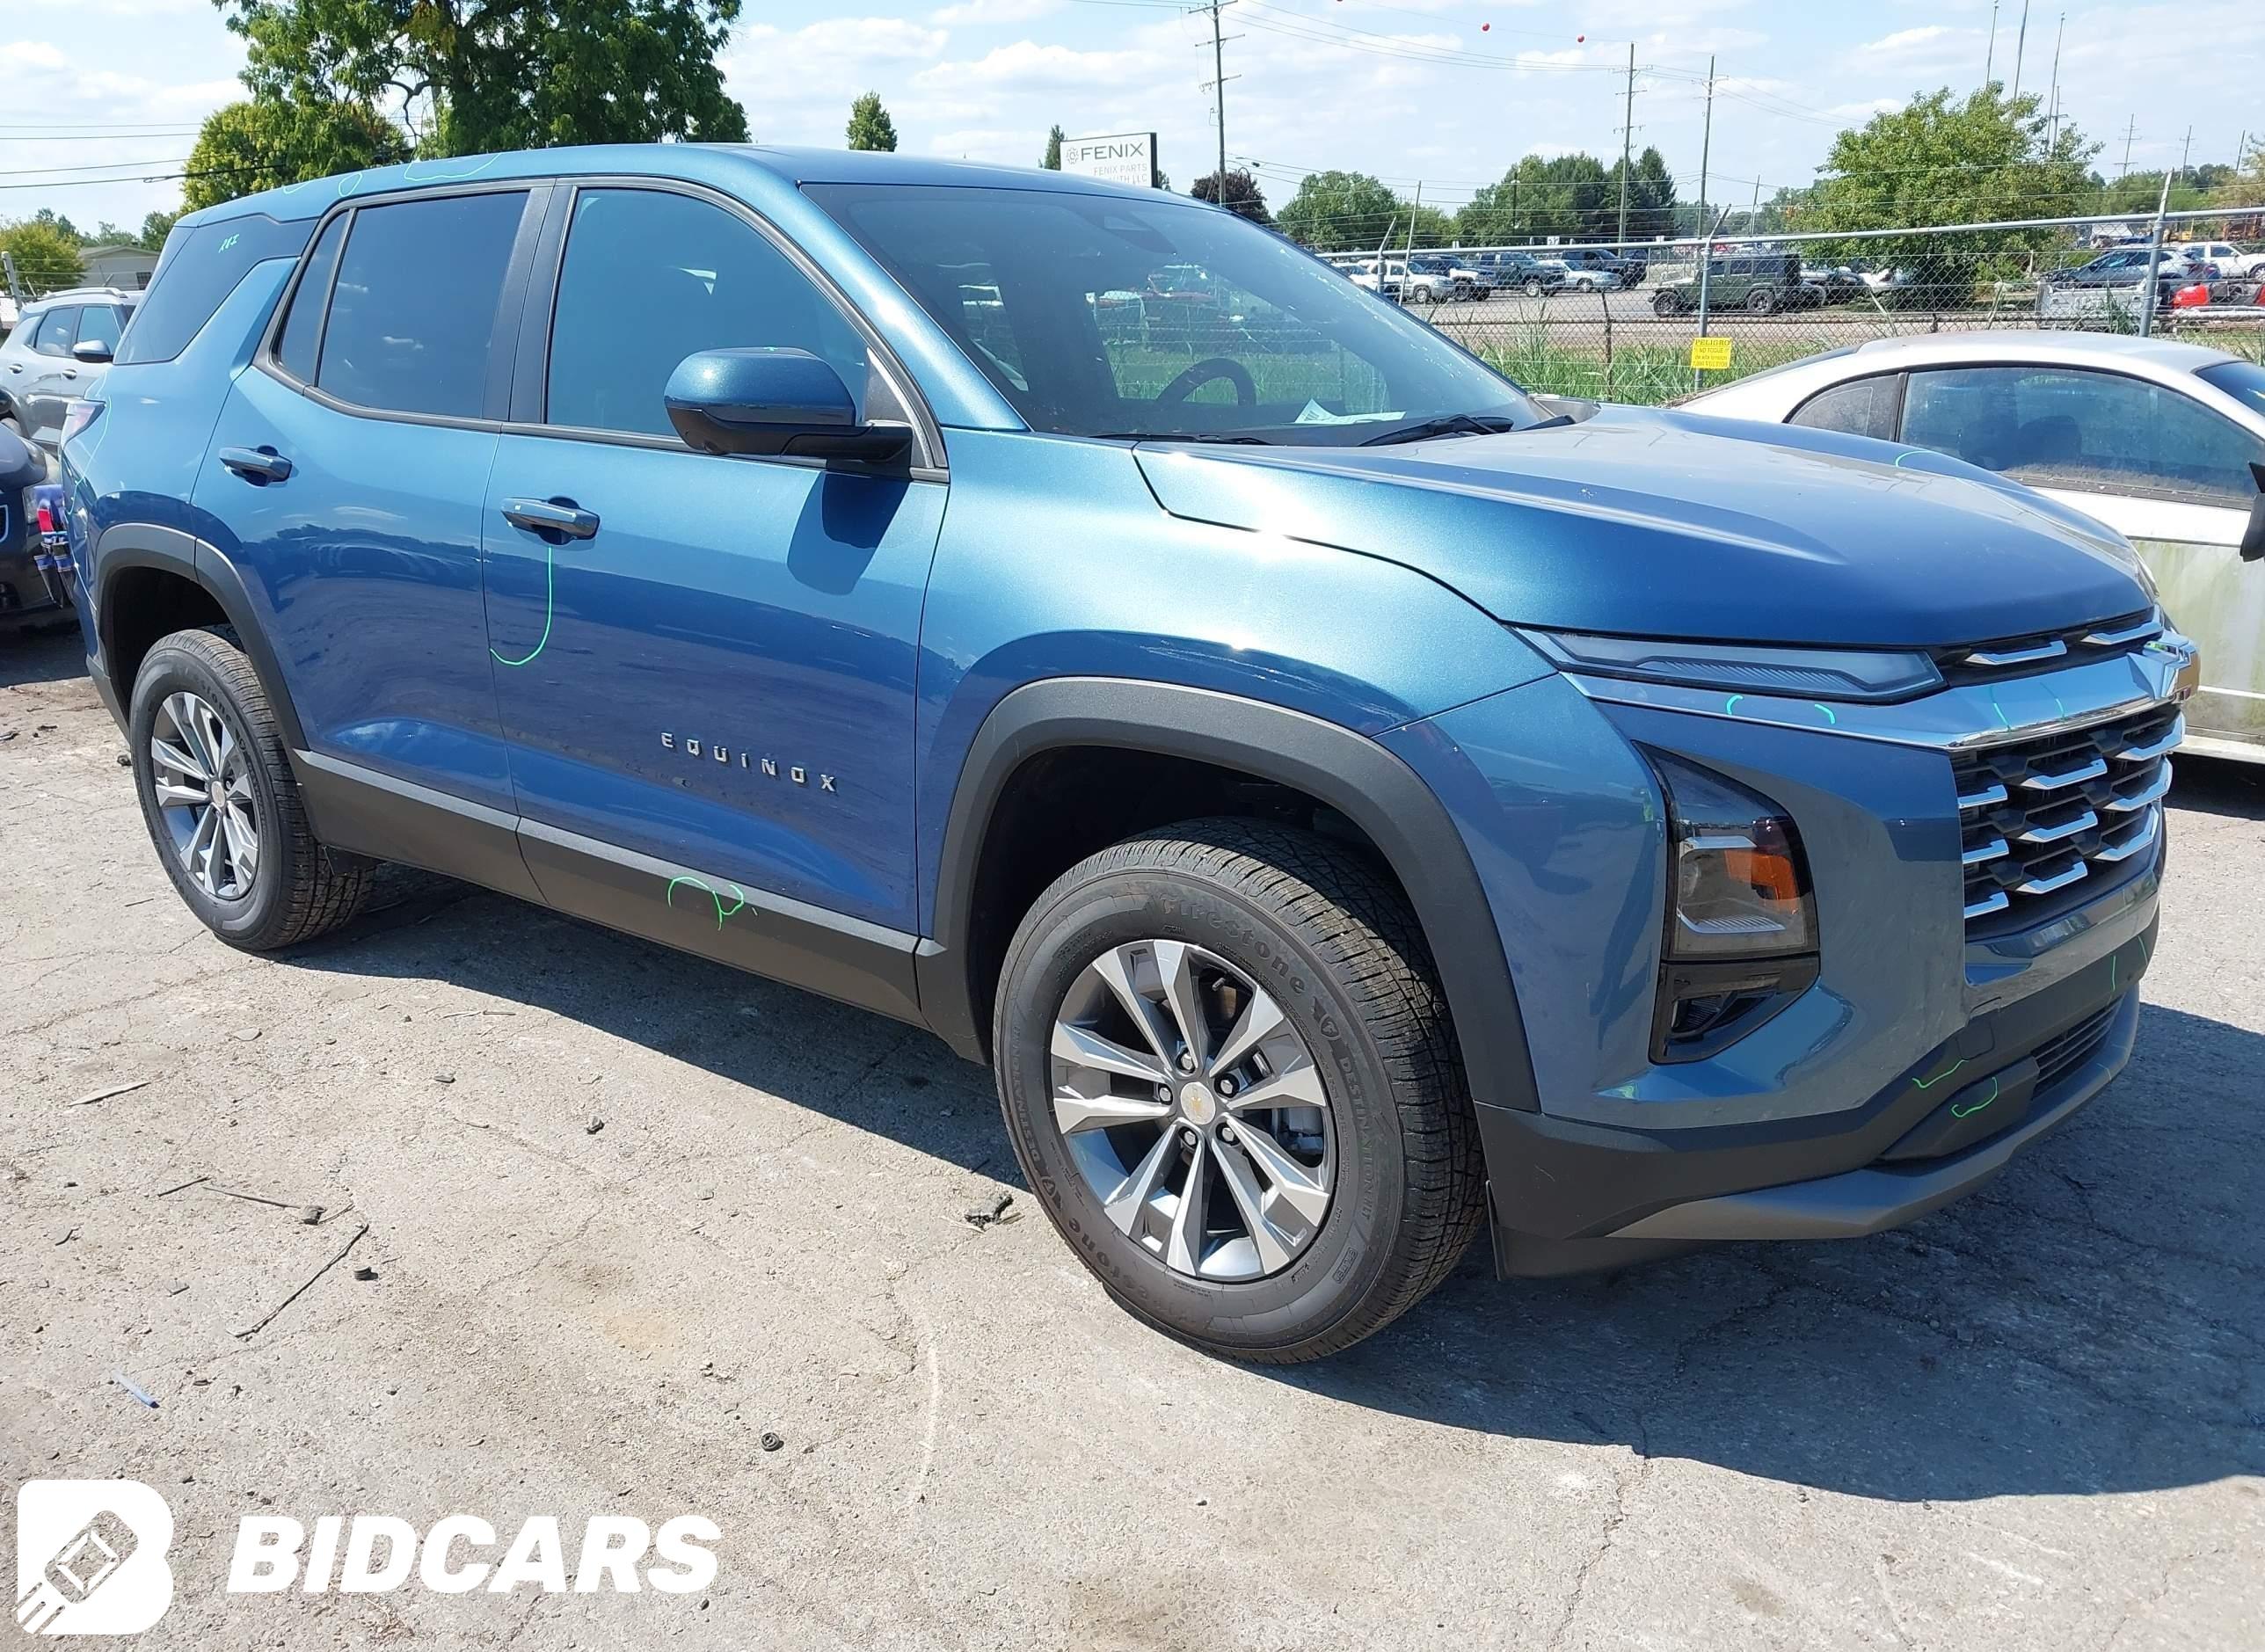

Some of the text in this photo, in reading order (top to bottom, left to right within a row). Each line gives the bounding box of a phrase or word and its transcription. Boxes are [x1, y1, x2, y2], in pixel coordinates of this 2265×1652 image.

[1081, 142, 1144, 161] FENIX
[1093, 163, 1147, 176] FENIX PARTS
[661, 732, 836, 792] EQUINOX
[1160, 893, 1307, 995] Firestone
